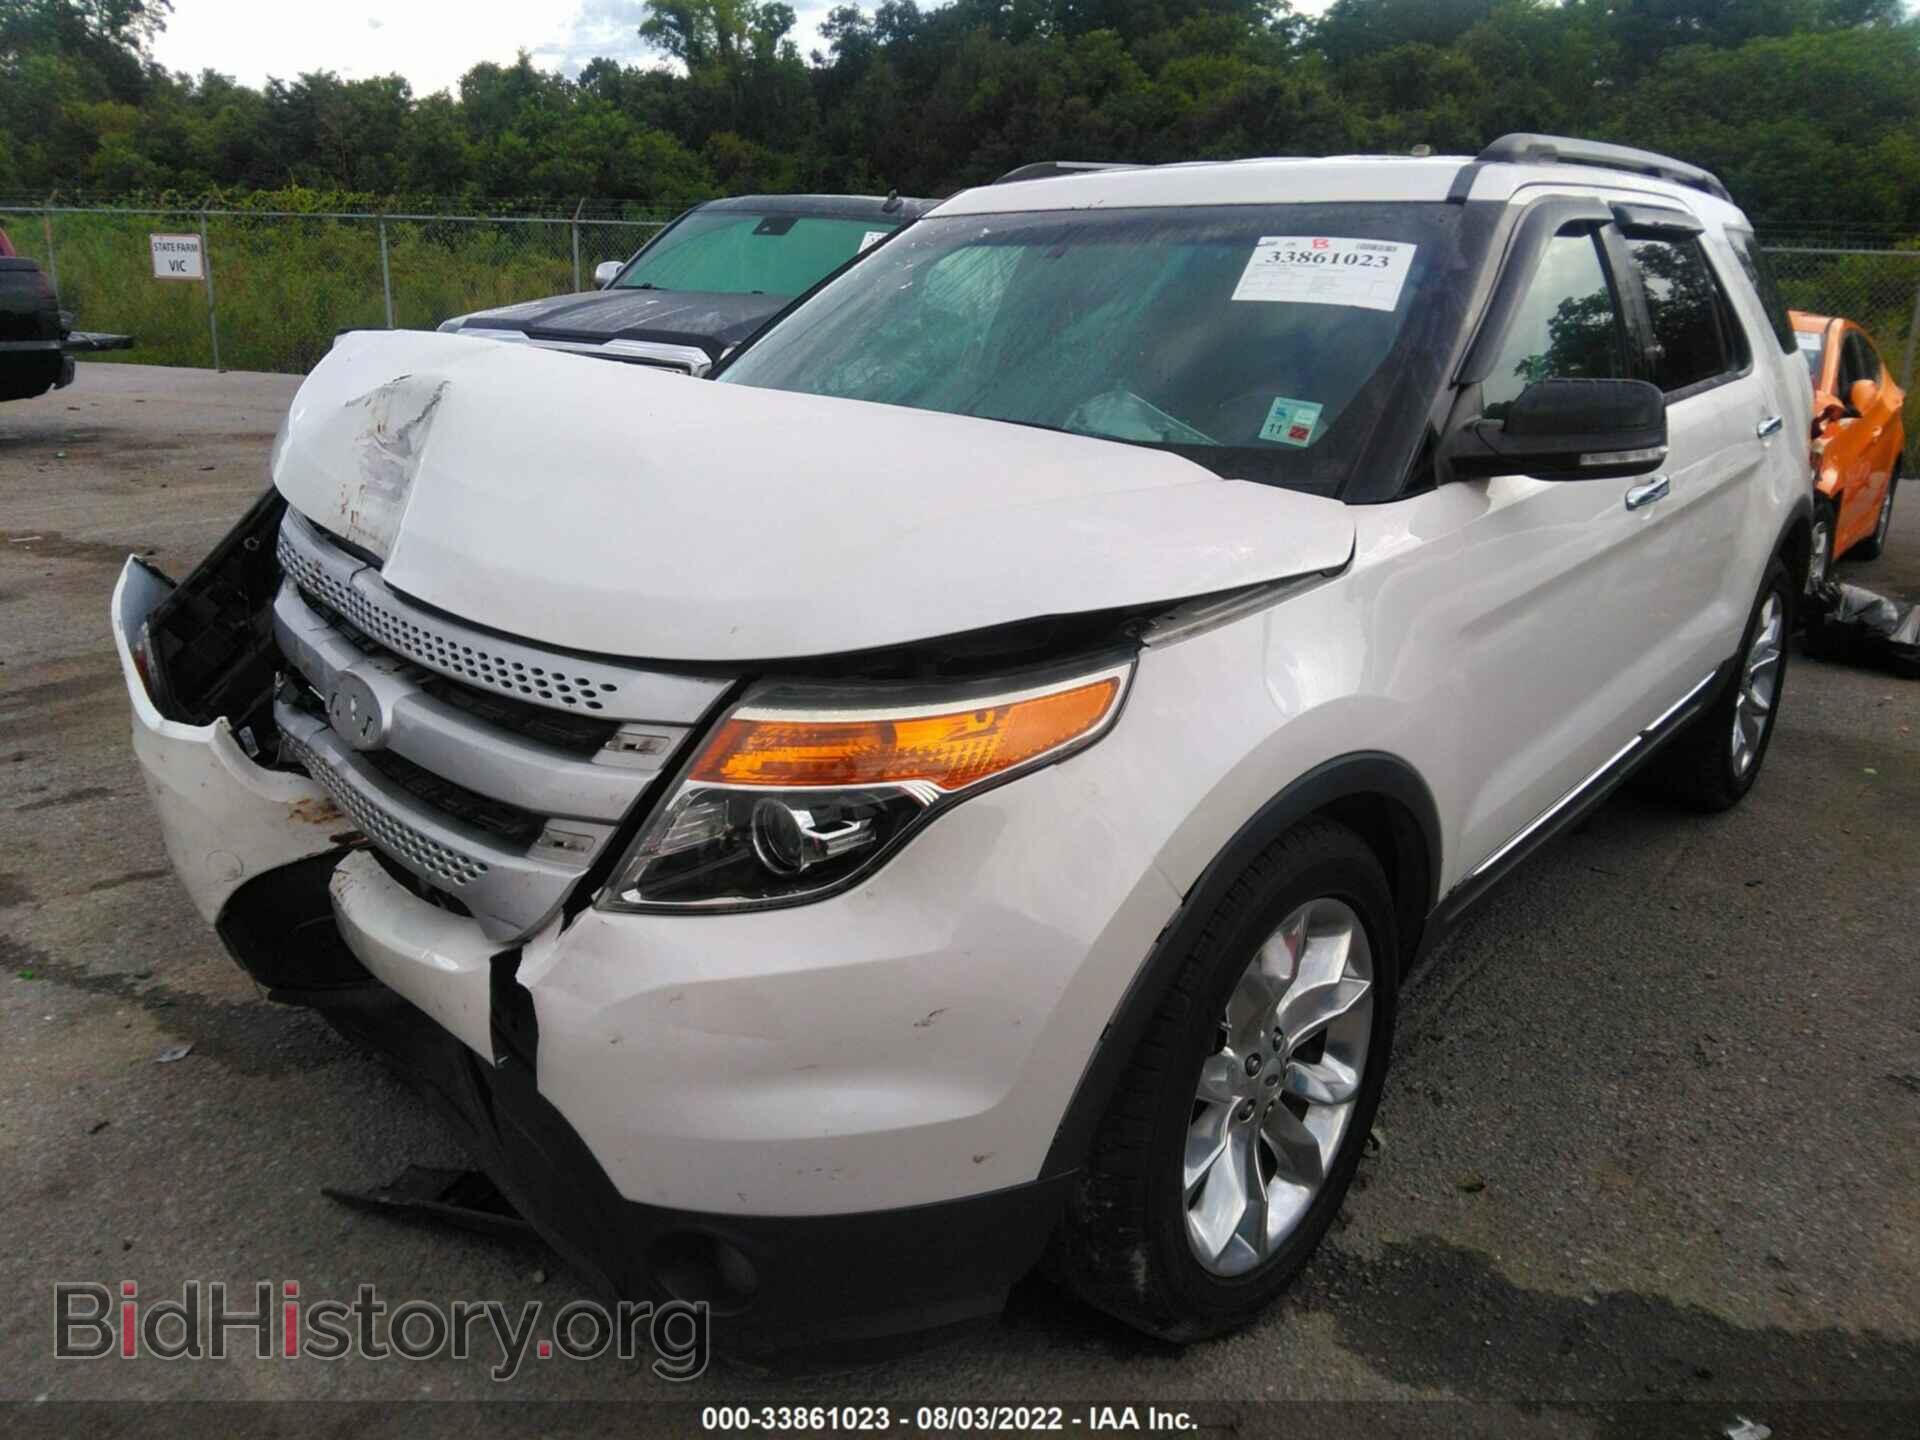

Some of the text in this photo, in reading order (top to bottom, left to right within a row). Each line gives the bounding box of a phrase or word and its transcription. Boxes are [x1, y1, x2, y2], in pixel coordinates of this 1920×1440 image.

[153, 242, 198, 252] STATE FARM
[168, 259, 187, 272] VIC
[1265, 250, 1390, 268] 33861023
